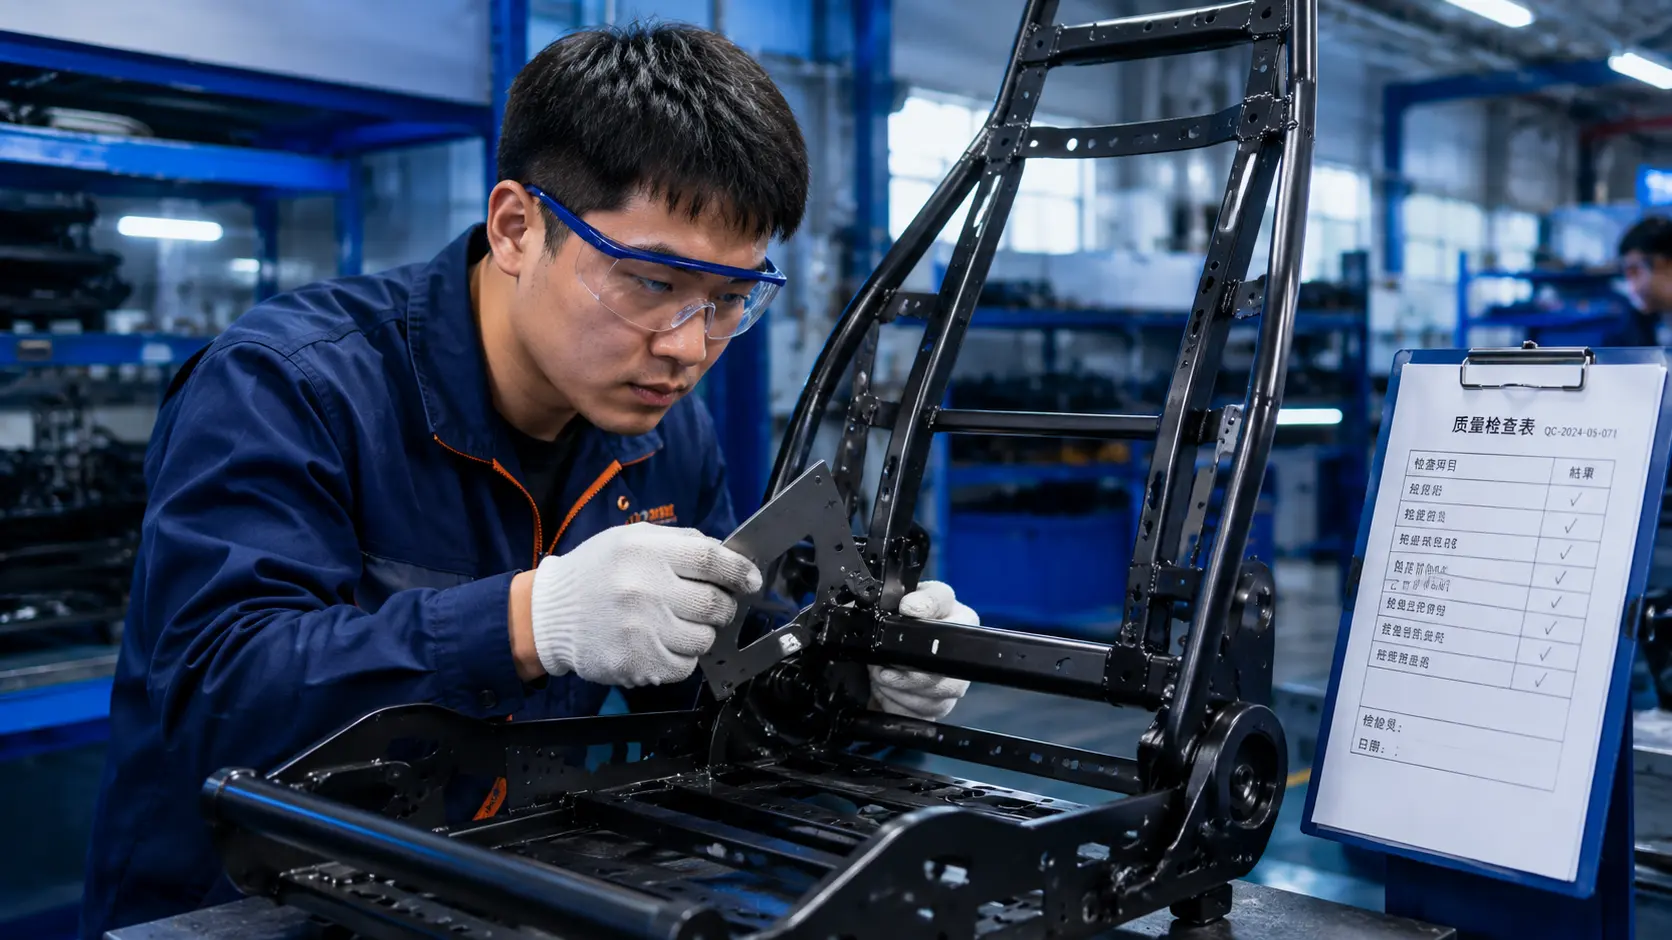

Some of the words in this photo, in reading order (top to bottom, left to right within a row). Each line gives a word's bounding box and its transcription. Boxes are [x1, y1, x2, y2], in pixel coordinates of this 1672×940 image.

[1452, 415, 1535, 436] 质量检查表
